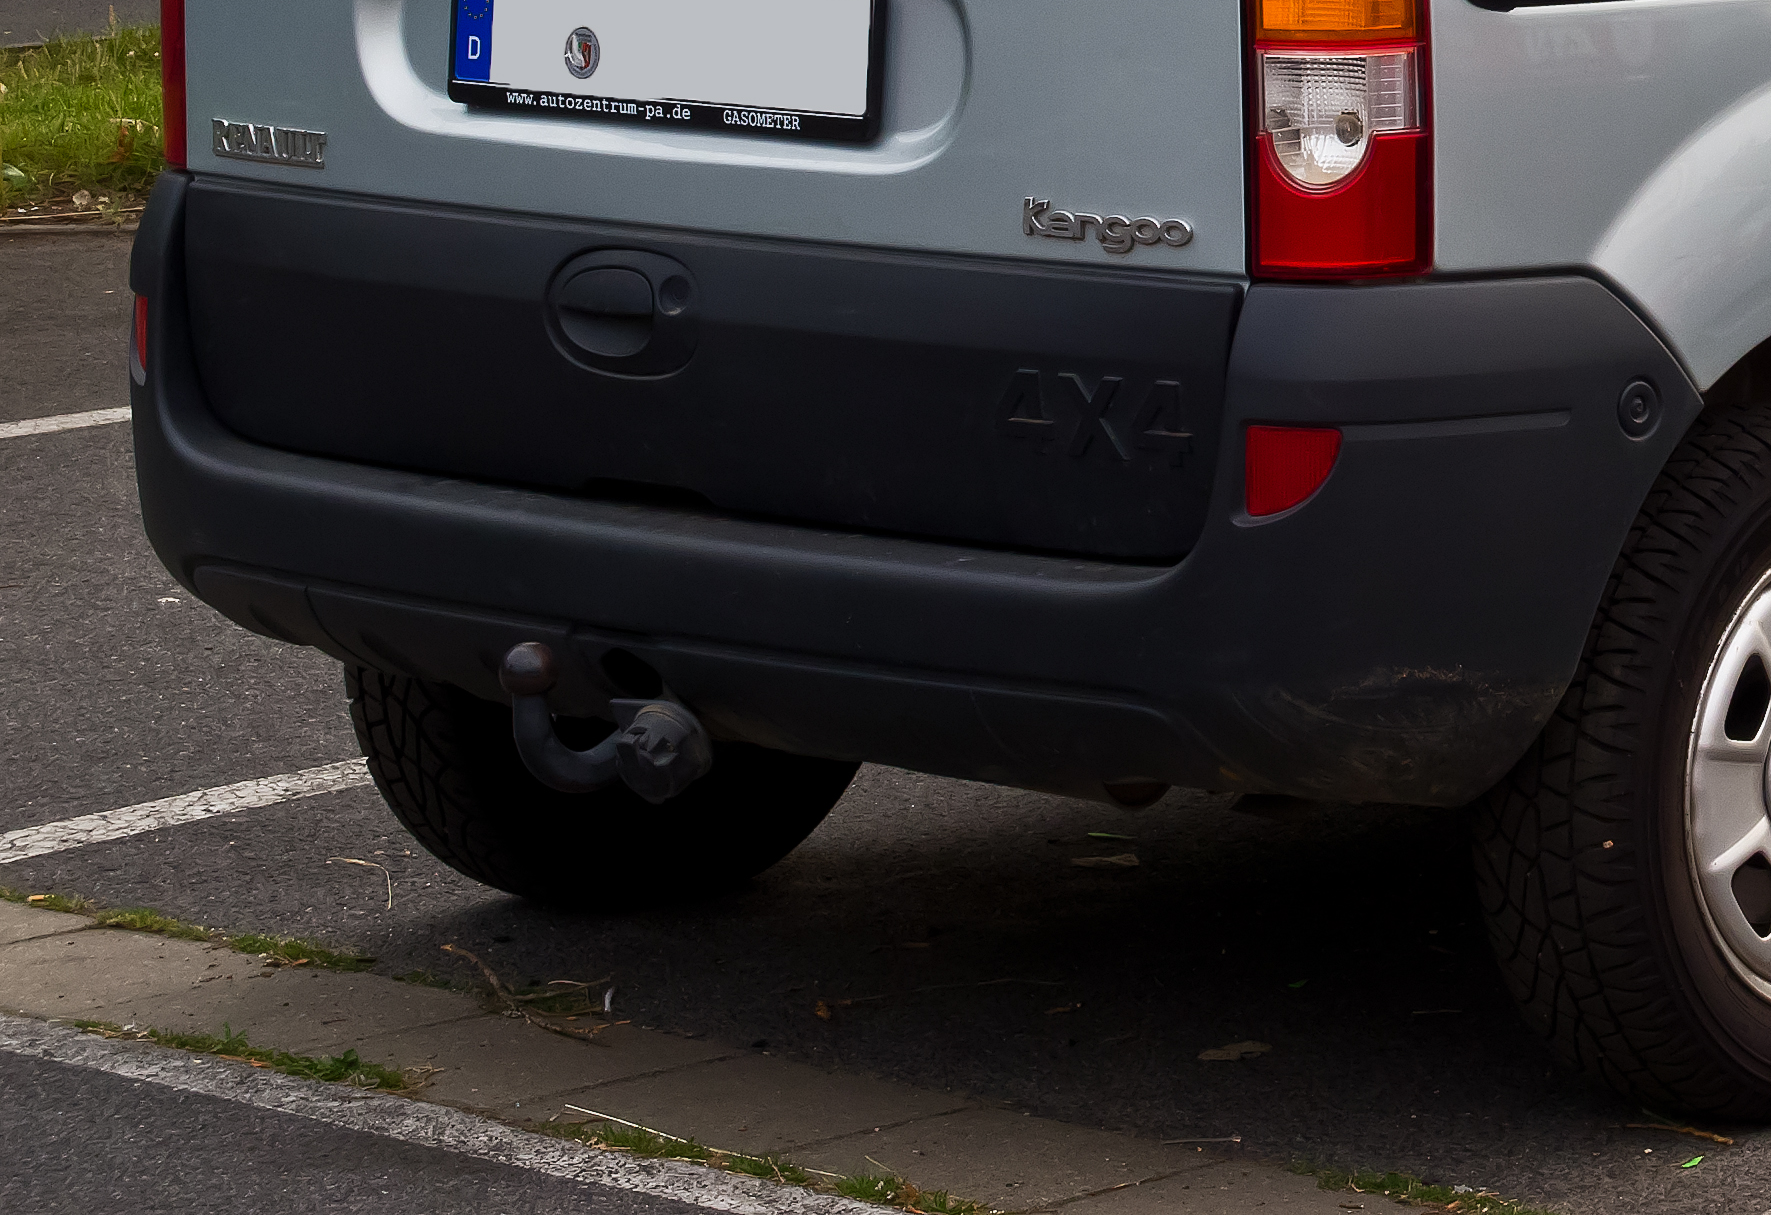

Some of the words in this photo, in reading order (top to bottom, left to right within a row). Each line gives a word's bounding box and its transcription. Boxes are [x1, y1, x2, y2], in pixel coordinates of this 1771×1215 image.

[468, 35, 481, 60] D
[506, 91, 691, 120] www.autozentrum-pa.de
[723, 109, 801, 130] GASOMETER
[212, 117, 328, 167] RENAULT
[1022, 196, 1194, 253] Kangoo
